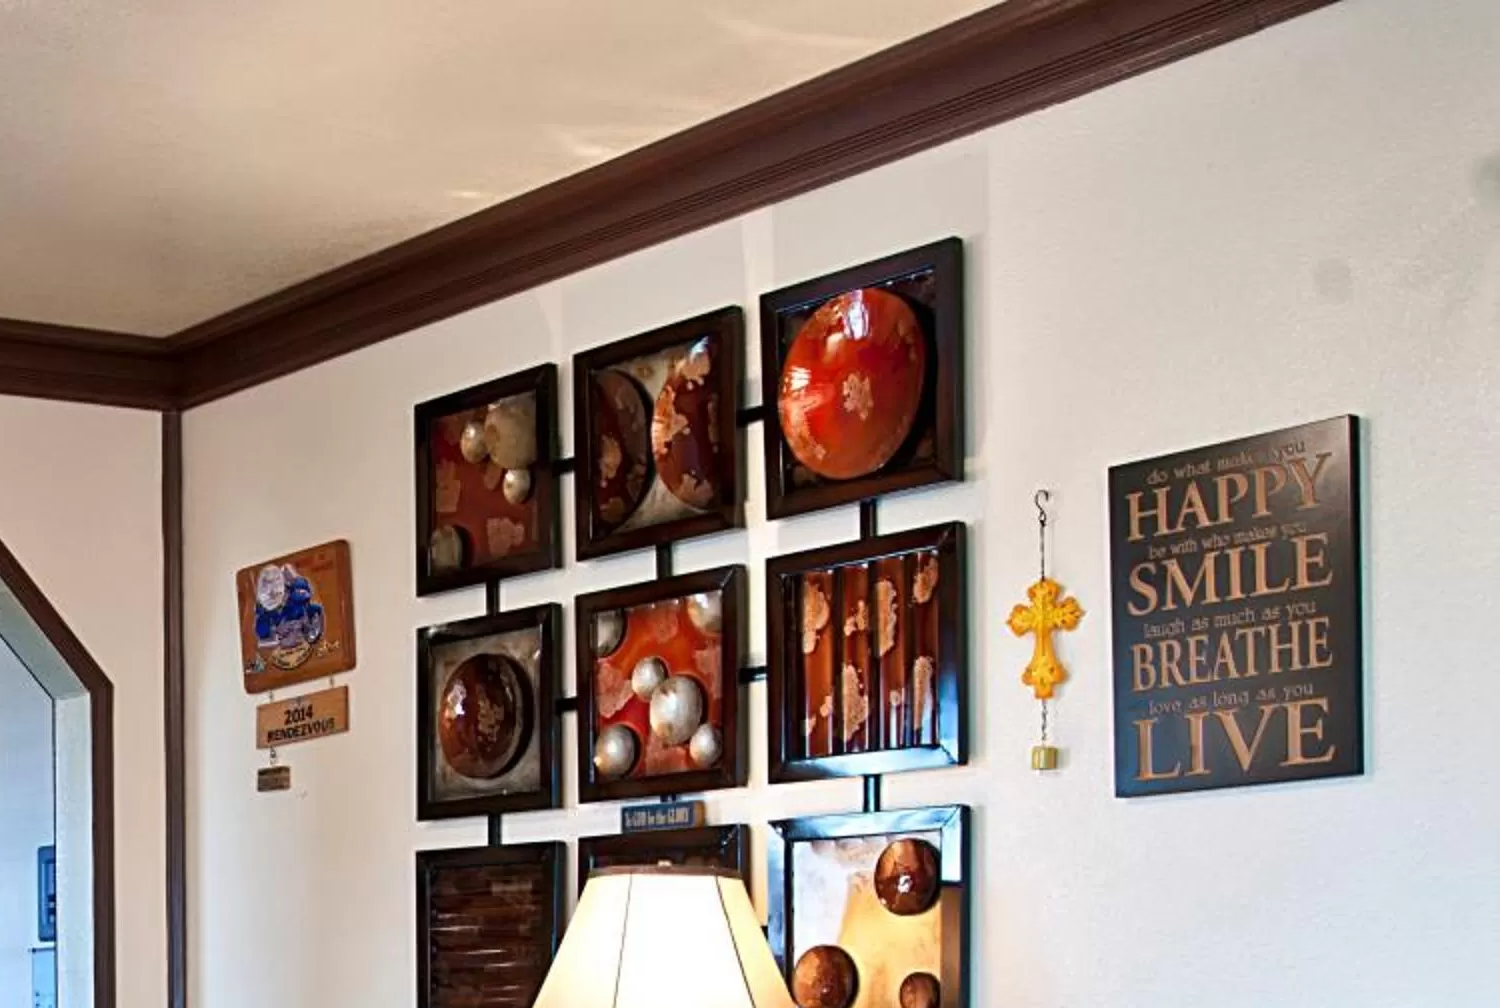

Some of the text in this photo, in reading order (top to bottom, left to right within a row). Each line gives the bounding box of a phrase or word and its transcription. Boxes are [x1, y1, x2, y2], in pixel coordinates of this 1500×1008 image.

[1147, 465, 1168, 485] do
[1173, 456, 1212, 480] what
[1125, 453, 1332, 541] HAPPY
[1149, 543, 1167, 560] be
[1171, 538, 1197, 555] with
[1202, 532, 1230, 550] who
[1126, 531, 1333, 616] SMILE
[1143, 600, 1317, 640] laugh as much as you
[1131, 617, 1333, 692] BREATHE
[284, 704, 313, 725] 2014
[1148, 682, 1314, 716] love as long as you
[267, 717, 335, 743] RENDEZVOUS
[1132, 698, 1336, 781] LIVE
